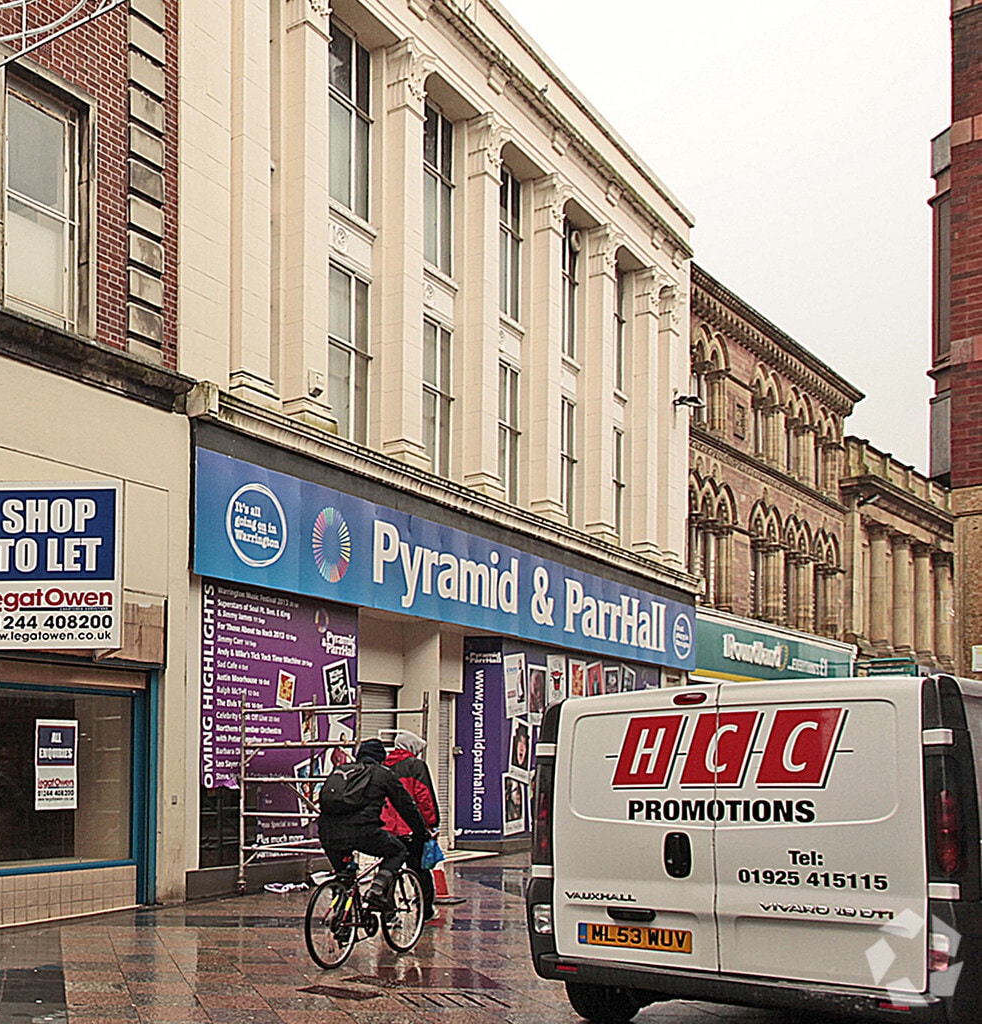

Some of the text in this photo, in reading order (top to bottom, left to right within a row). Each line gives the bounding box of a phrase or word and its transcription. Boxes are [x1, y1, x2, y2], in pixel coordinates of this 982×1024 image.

[2, 498, 96, 534] SHOP
[235, 501, 261, 518] It's all
[235, 516, 277, 534] going on in
[234, 529, 279, 548] Warrington
[46, 537, 102, 572] LET
[372, 519, 668, 654] Pyramid & ParrHall
[44, 615, 113, 629] 408200
[326, 631, 356, 646] Pyramid
[202, 584, 214, 788] OMING HIGHLIGHTS
[51, 732, 62, 743] ALL
[472, 670, 485, 821] www.pyramidparrhall.com
[39, 748, 73, 760] ENQUIRIES
[628, 799, 816, 823] PROMOTIONS
[789, 850, 824, 866] Tel:
[738, 869, 888, 891] 01925 415115
[564, 892, 637, 902] VAUXHALL
[759, 902, 830, 915] VIVARO
[860, 909, 894, 920] DTI
[591, 925, 687, 948] ML53 WUV
